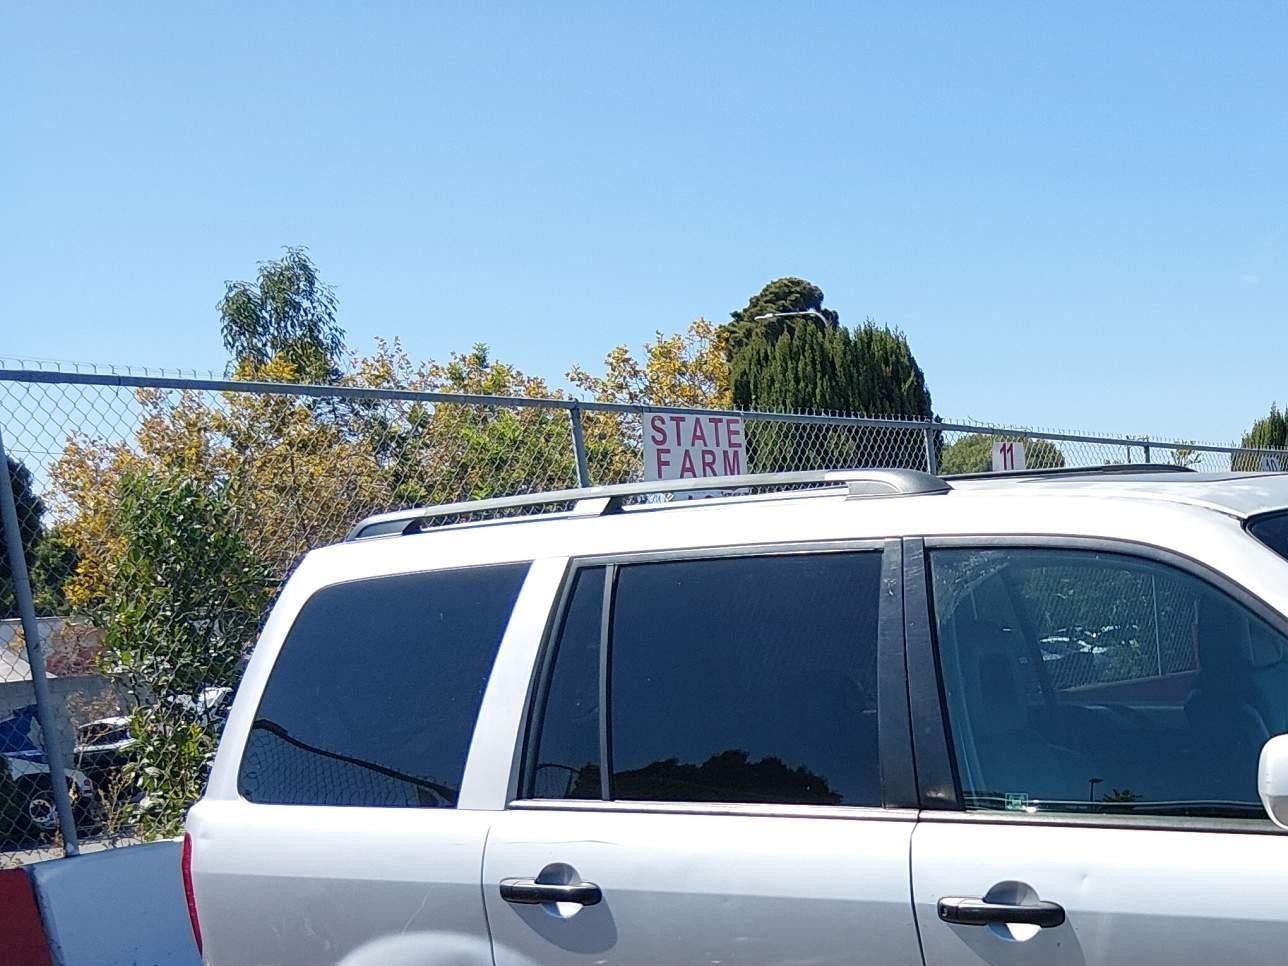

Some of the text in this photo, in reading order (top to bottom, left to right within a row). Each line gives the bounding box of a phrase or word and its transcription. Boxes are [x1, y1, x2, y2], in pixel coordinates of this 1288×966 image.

[650, 415, 743, 449] STATE
[656, 448, 741, 479] FARM
[999, 442, 1015, 470] 11
